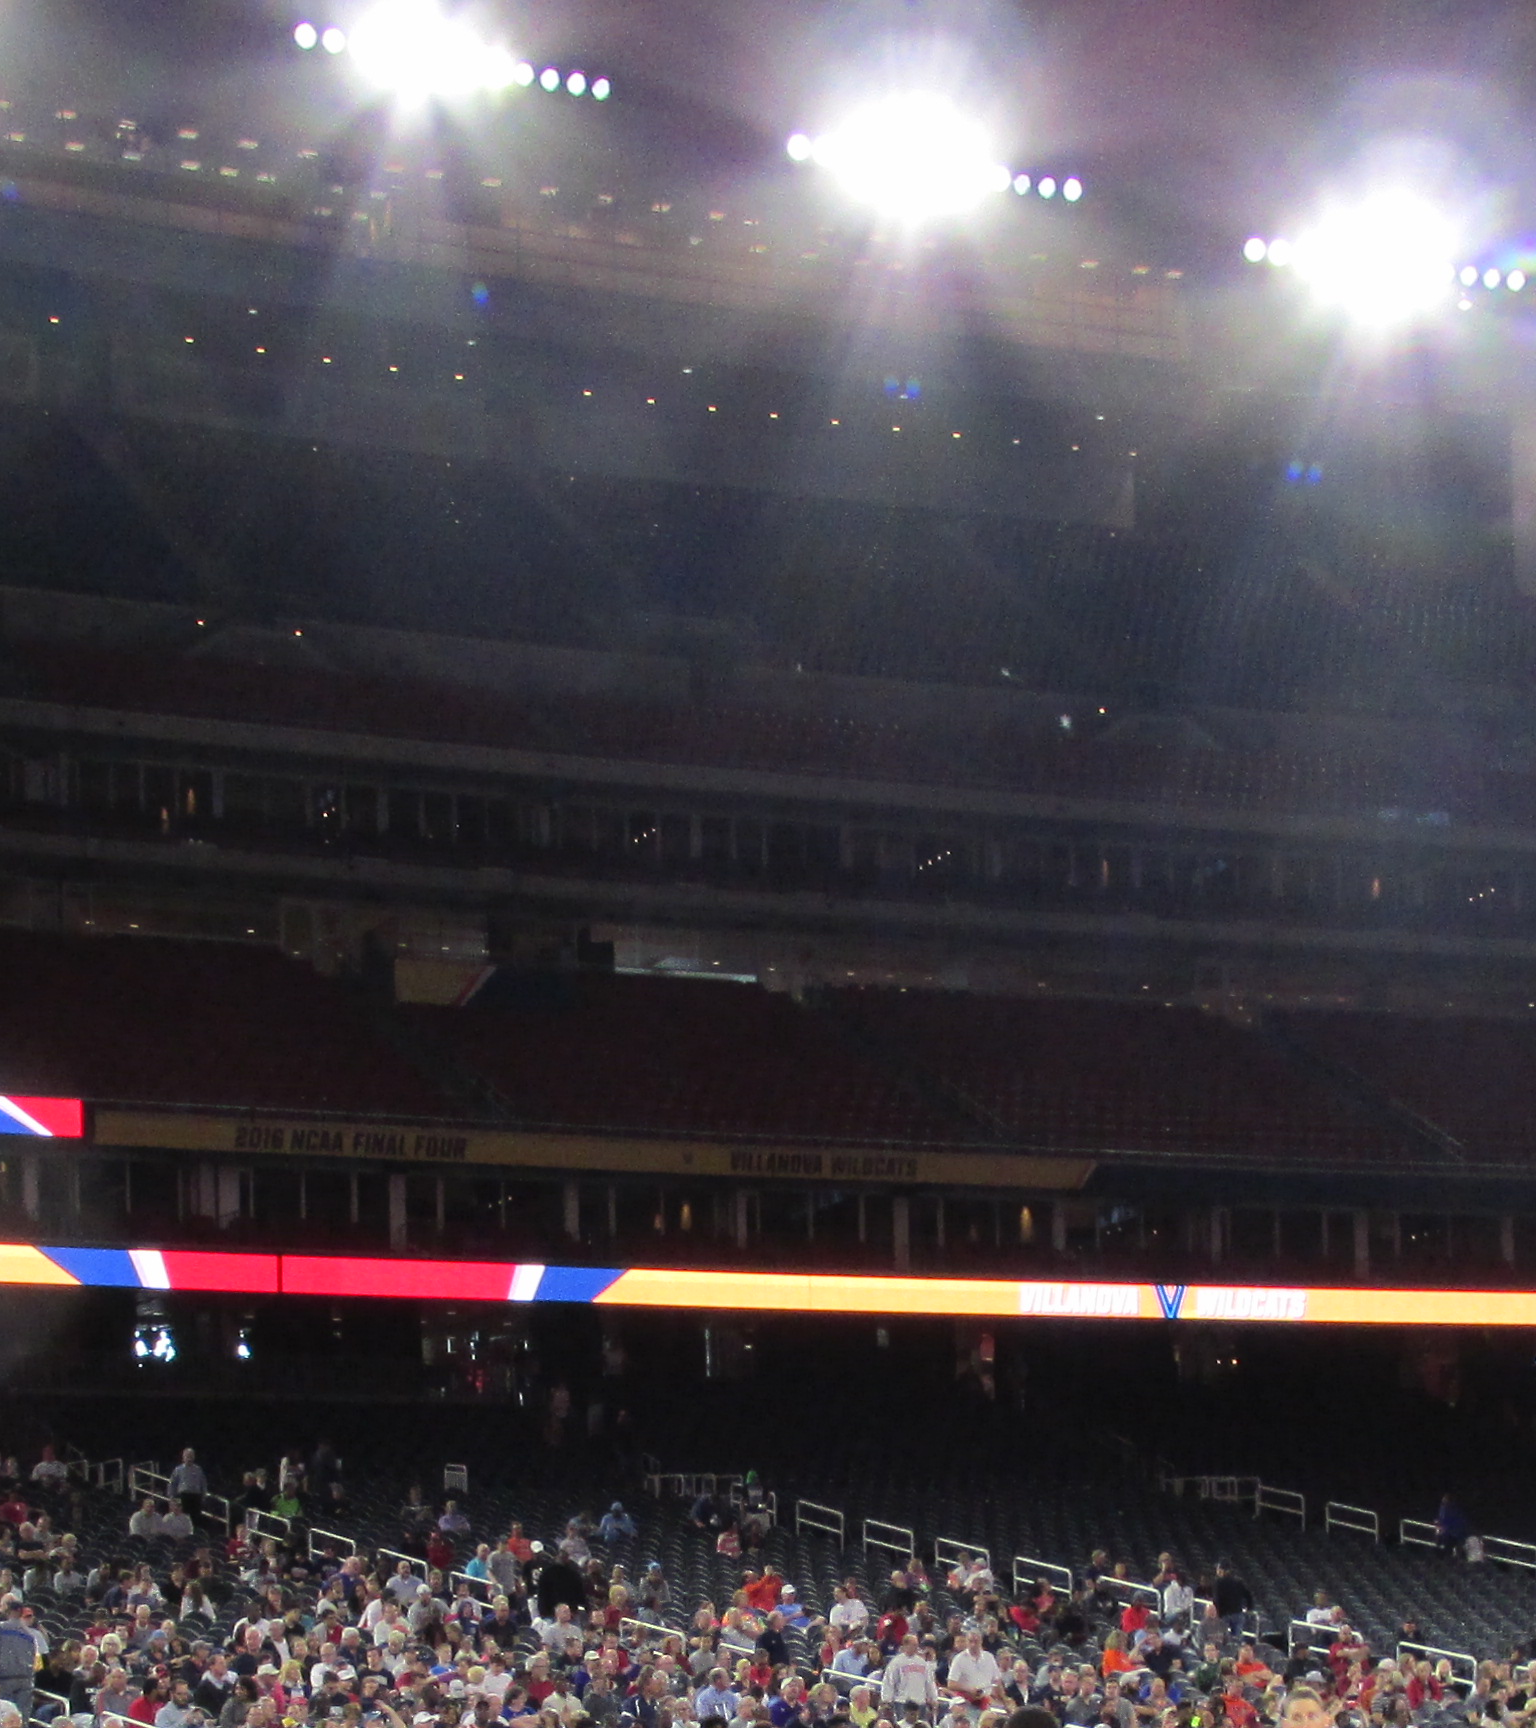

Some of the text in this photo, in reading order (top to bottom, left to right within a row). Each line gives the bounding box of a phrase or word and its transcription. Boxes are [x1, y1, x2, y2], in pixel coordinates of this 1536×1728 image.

[234, 1126, 467, 1158] 2016 NCAA FINAL FOUR
[731, 1151, 918, 1176] VILLANOVA WILDCATS
[1019, 1286, 1139, 1315] VILLANOVA
[1197, 1289, 1306, 1318] WILDCATS
